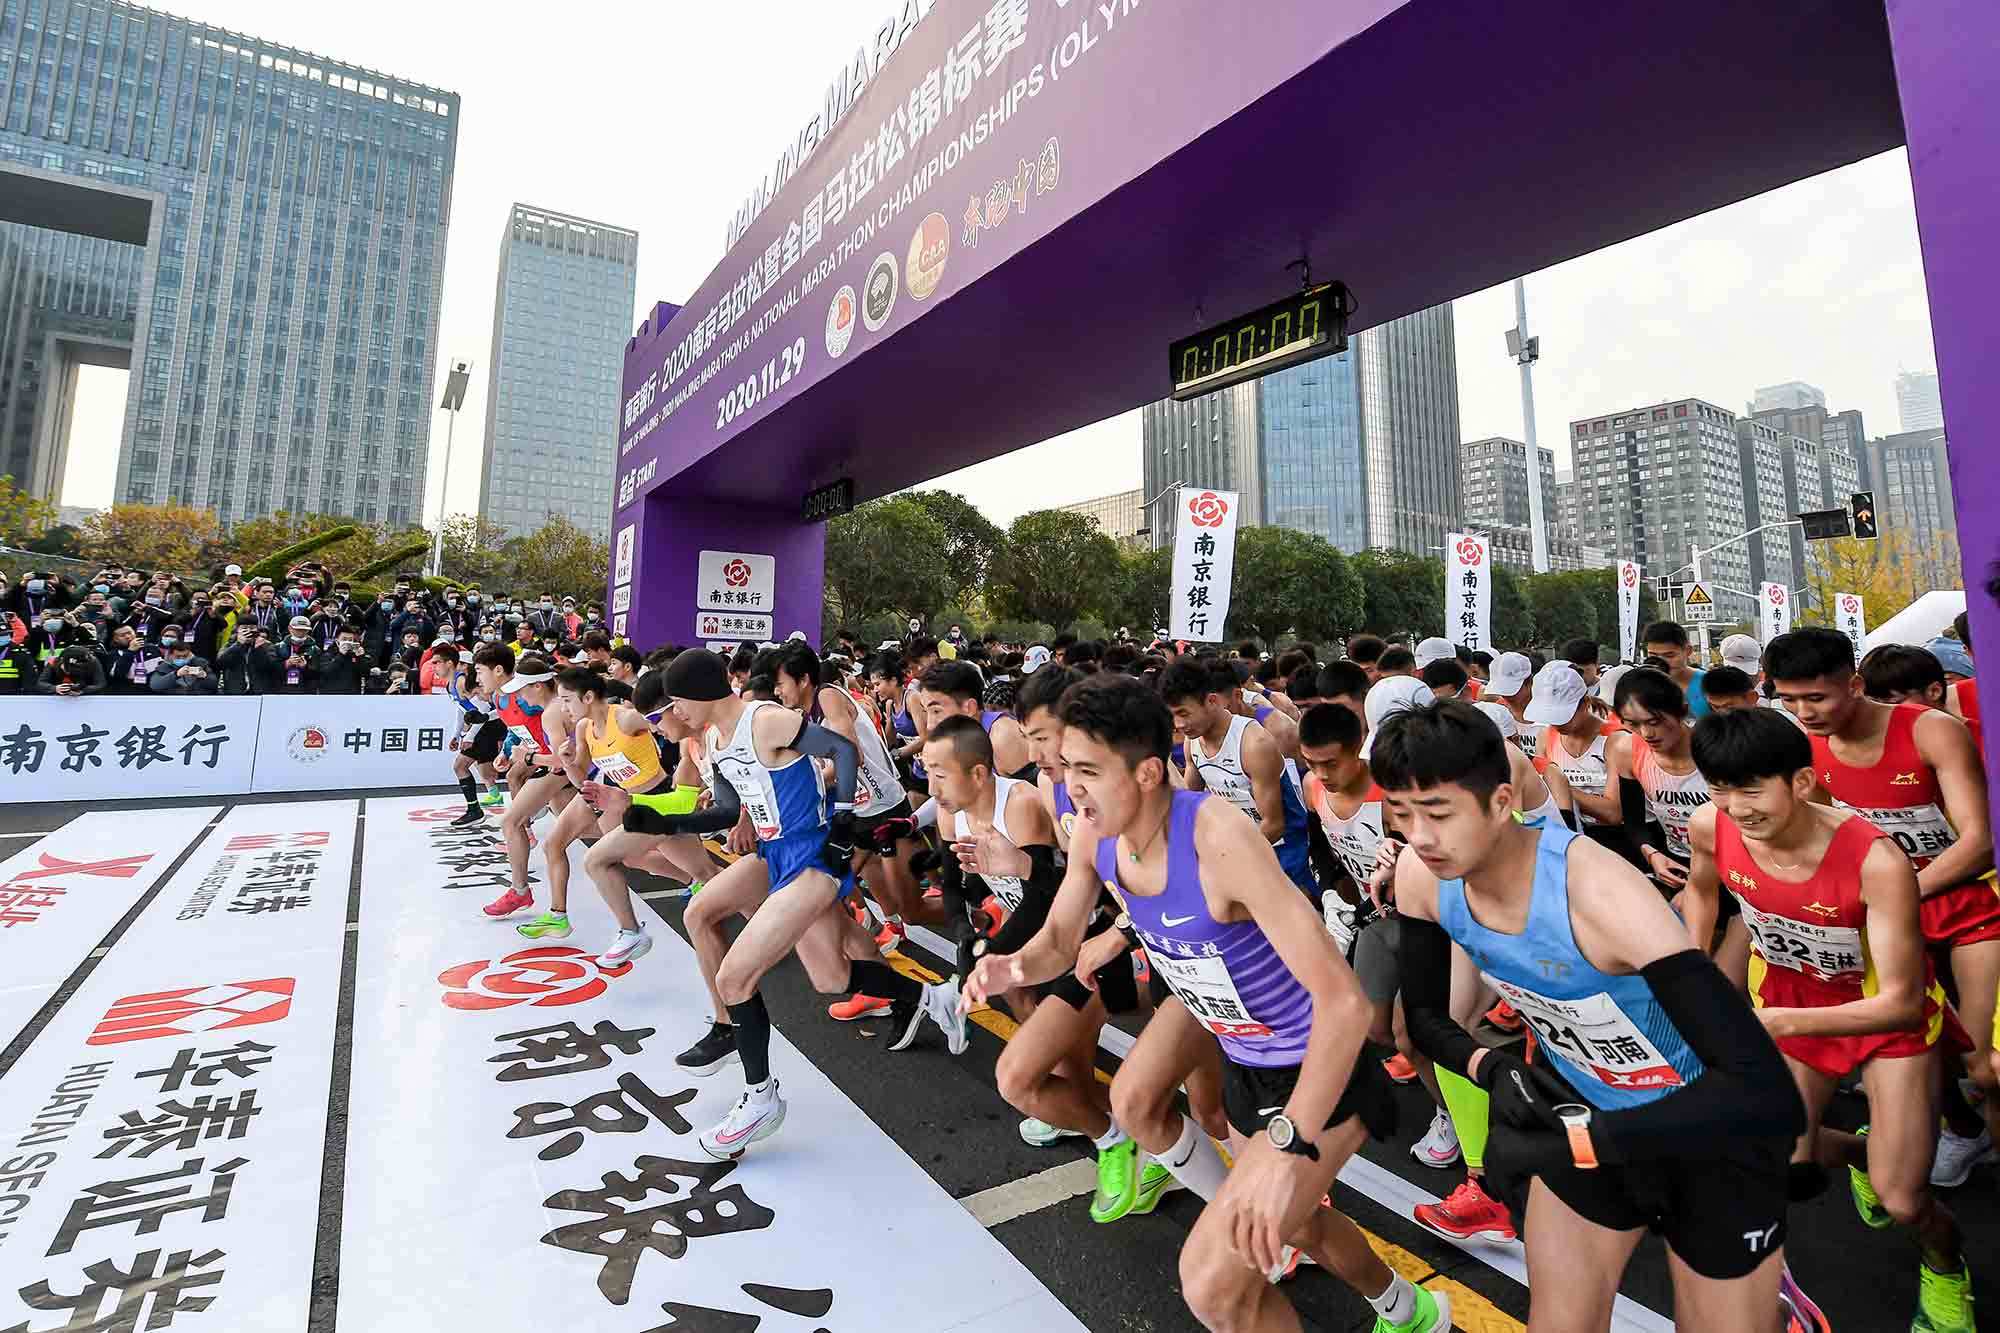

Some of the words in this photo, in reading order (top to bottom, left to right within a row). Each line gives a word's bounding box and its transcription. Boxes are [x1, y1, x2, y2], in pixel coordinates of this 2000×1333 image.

[823, 0, 937, 136] MARA
[700, 339, 742, 386] MARATHON
[743, 330, 750, 350] &
[750, 285, 799, 344] NATIONAL
[802, 214, 875, 296] MARATHON
[878, 63, 1044, 228] CHAMPIONSHIPS
[716, 336, 806, 430] 2020.11.29
[722, 617, 766, 630] 华泰证券
[862, 766, 884, 800] salomo
[230, 849, 323, 915] 华泰证券
[1728, 869, 1757, 890] 吉林
[1817, 950, 1857, 971] 吉林
[1587, 1035, 1650, 1066] 河南
[17, 1060, 114, 1148] HUATAI
[0, 1039, 276, 1333] 华泰证券
